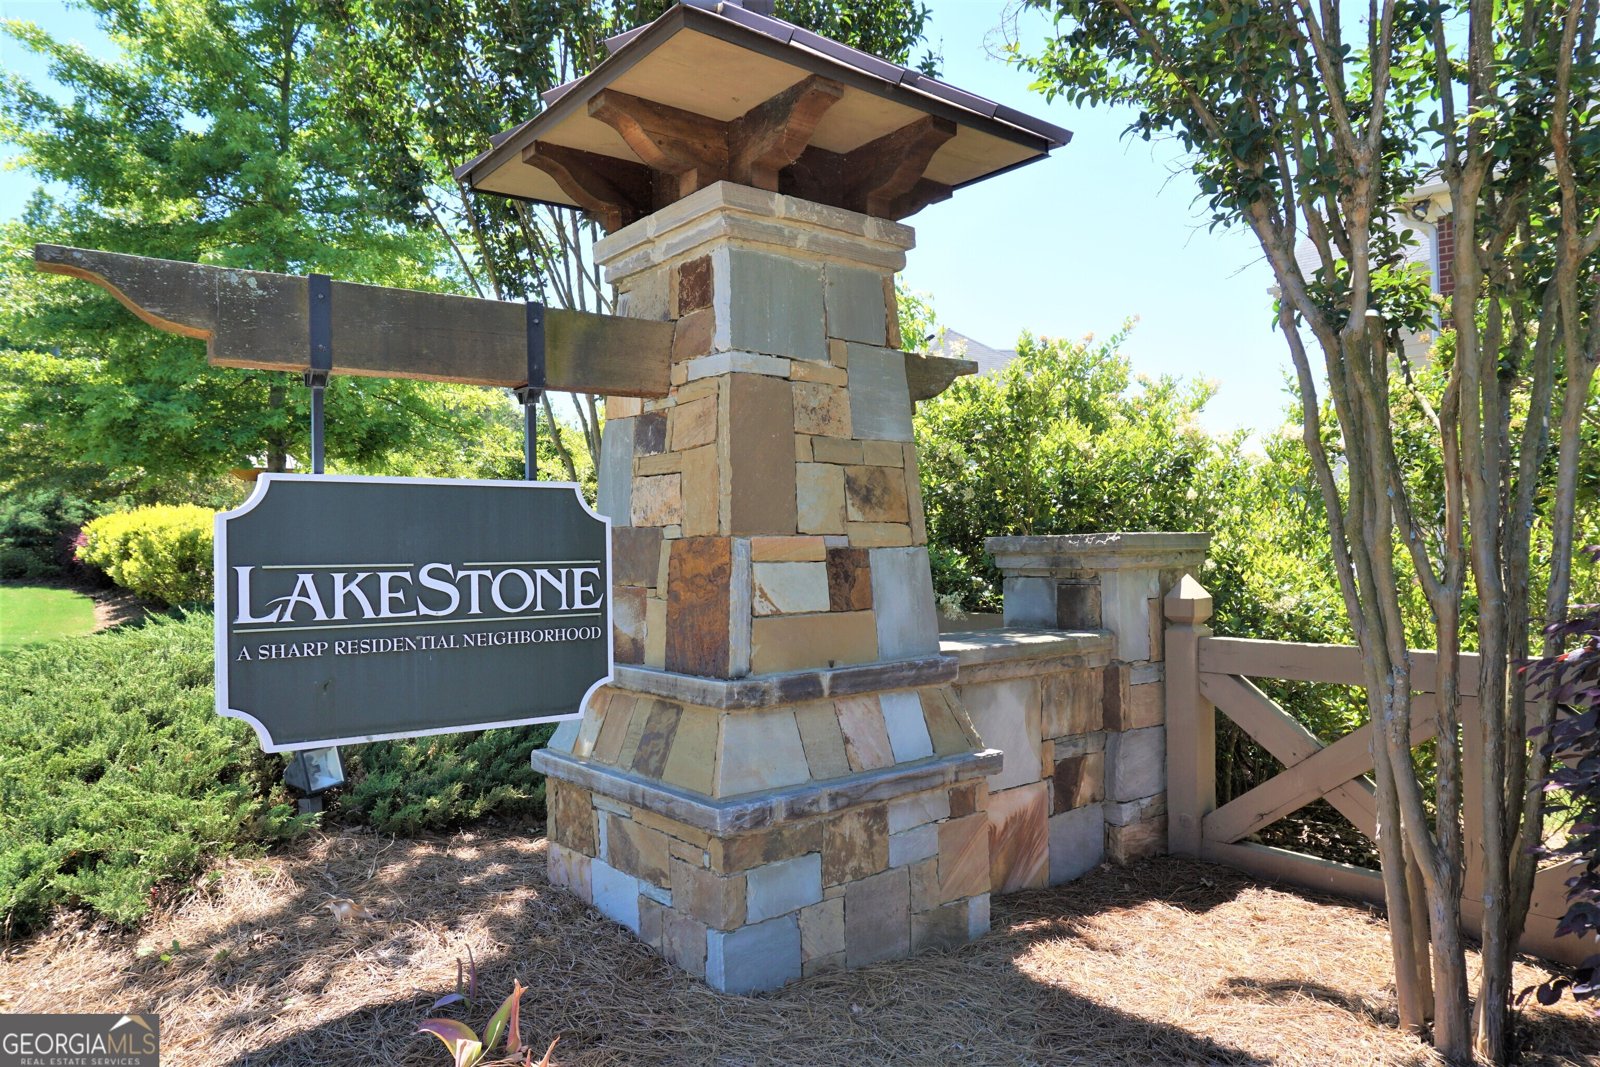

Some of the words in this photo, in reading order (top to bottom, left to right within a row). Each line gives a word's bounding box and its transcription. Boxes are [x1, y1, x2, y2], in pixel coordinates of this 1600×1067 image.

[232, 563, 604, 624] LAKESTONE
[236, 646, 252, 662] A
[258, 642, 329, 661] SHARP
[334, 635, 460, 656] RESIDENTIAL
[462, 626, 602, 648] NEIGHBORHOOD
